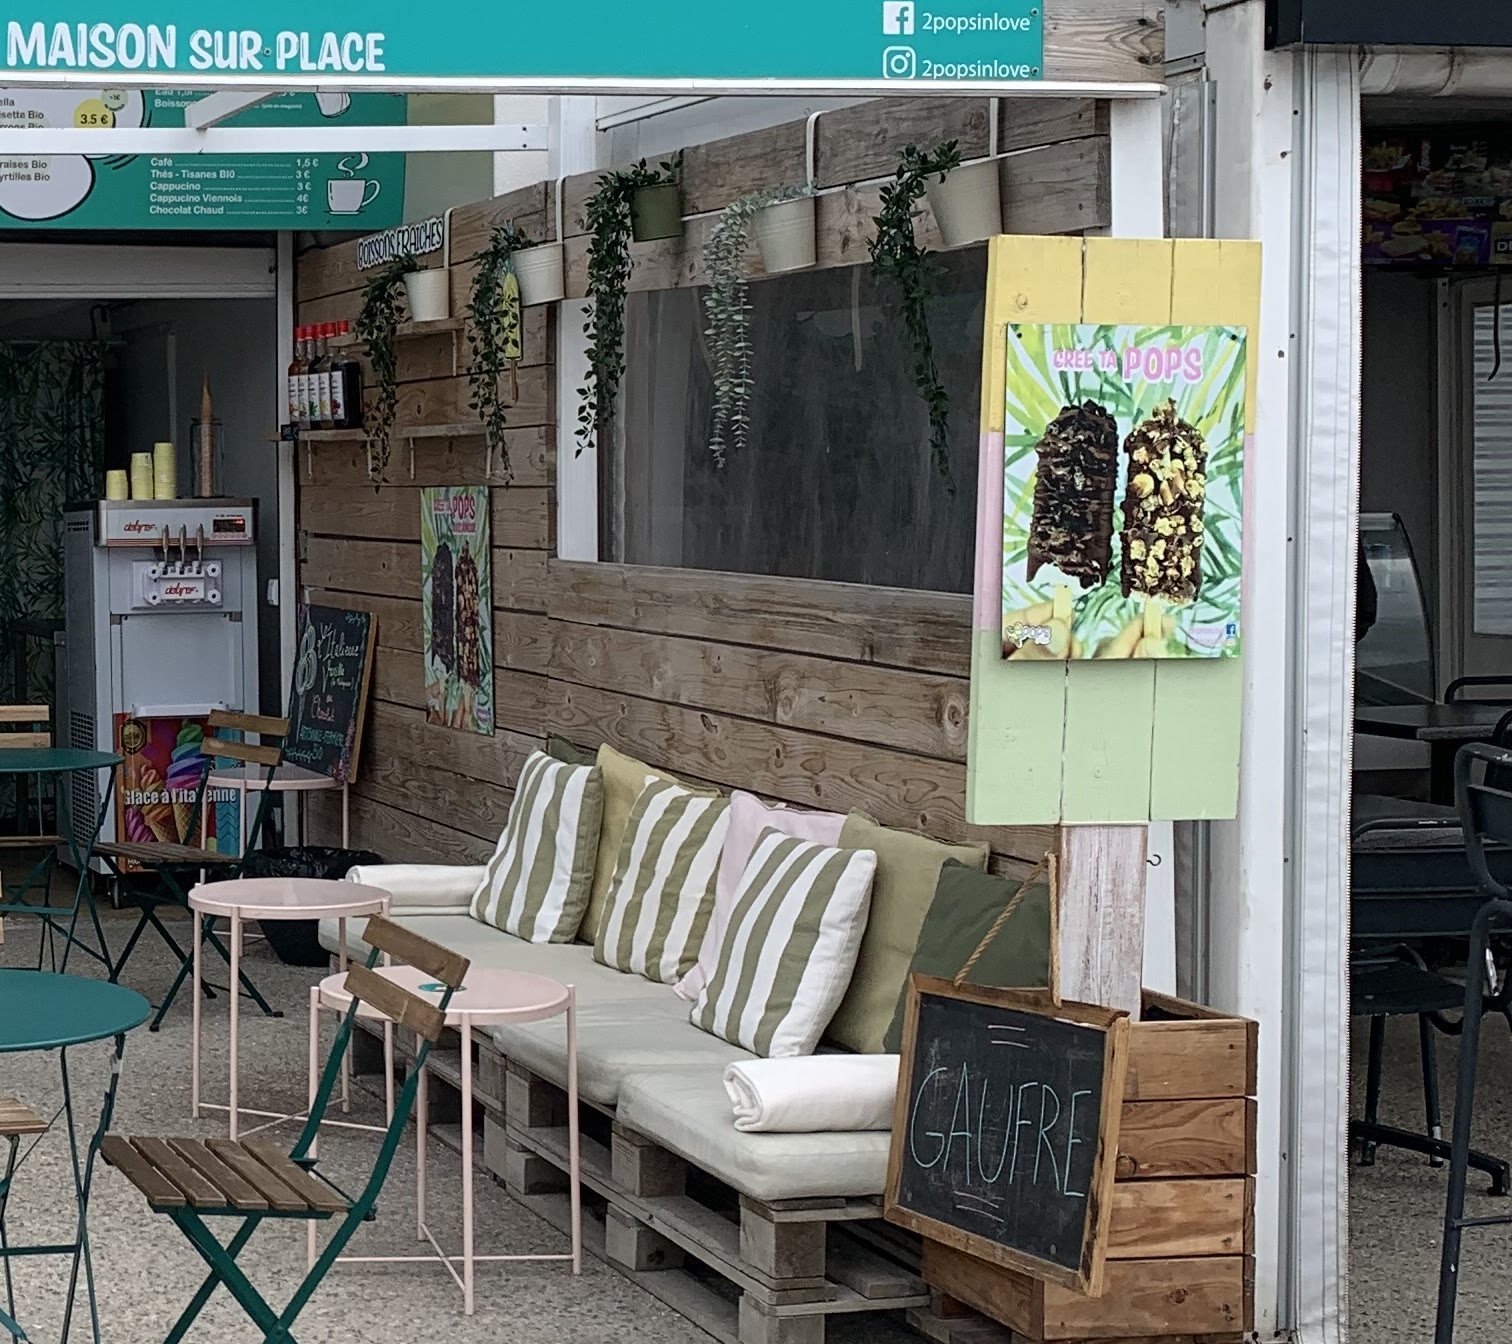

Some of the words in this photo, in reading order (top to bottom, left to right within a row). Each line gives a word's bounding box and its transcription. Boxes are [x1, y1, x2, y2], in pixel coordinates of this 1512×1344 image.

[922, 12, 1031, 34] 2popsinlove
[7, 22, 176, 69] MAISON
[189, 31, 265, 69] SUR
[276, 32, 385, 72] PLACE
[922, 59, 1031, 79] 2popsinlove
[27, 110, 44, 120] Bio
[31, 159, 47, 169] Bio
[150, 157, 173, 167] Café
[296, 158, 310, 168] 1,5
[312, 158, 319, 168] €
[34, 172, 50, 181] Bio
[150, 169, 174, 179] Thés
[181, 169, 217, 179] Tisanes
[296, 170, 302, 179] 3
[304, 170, 310, 179] €
[150, 182, 201, 191] Cappucino
[296, 182, 302, 191] 3
[305, 182, 312, 191] €
[149, 194, 201, 204] Cappucino
[202, 193, 243, 203] Viennois
[149, 206, 191, 215] Chocolat
[193, 205, 224, 215] Chaud
[1052, 343, 1093, 372] CRÉE
[1098, 350, 1117, 370] TA
[1123, 347, 1203, 382] POPS
[453, 496, 476, 519] POPS
[124, 790, 159, 805] Glace
[161, 789, 170, 804] à
[171, 787, 236, 804] l'itaenne
[910, 1061, 1092, 1197] GAUFRE
